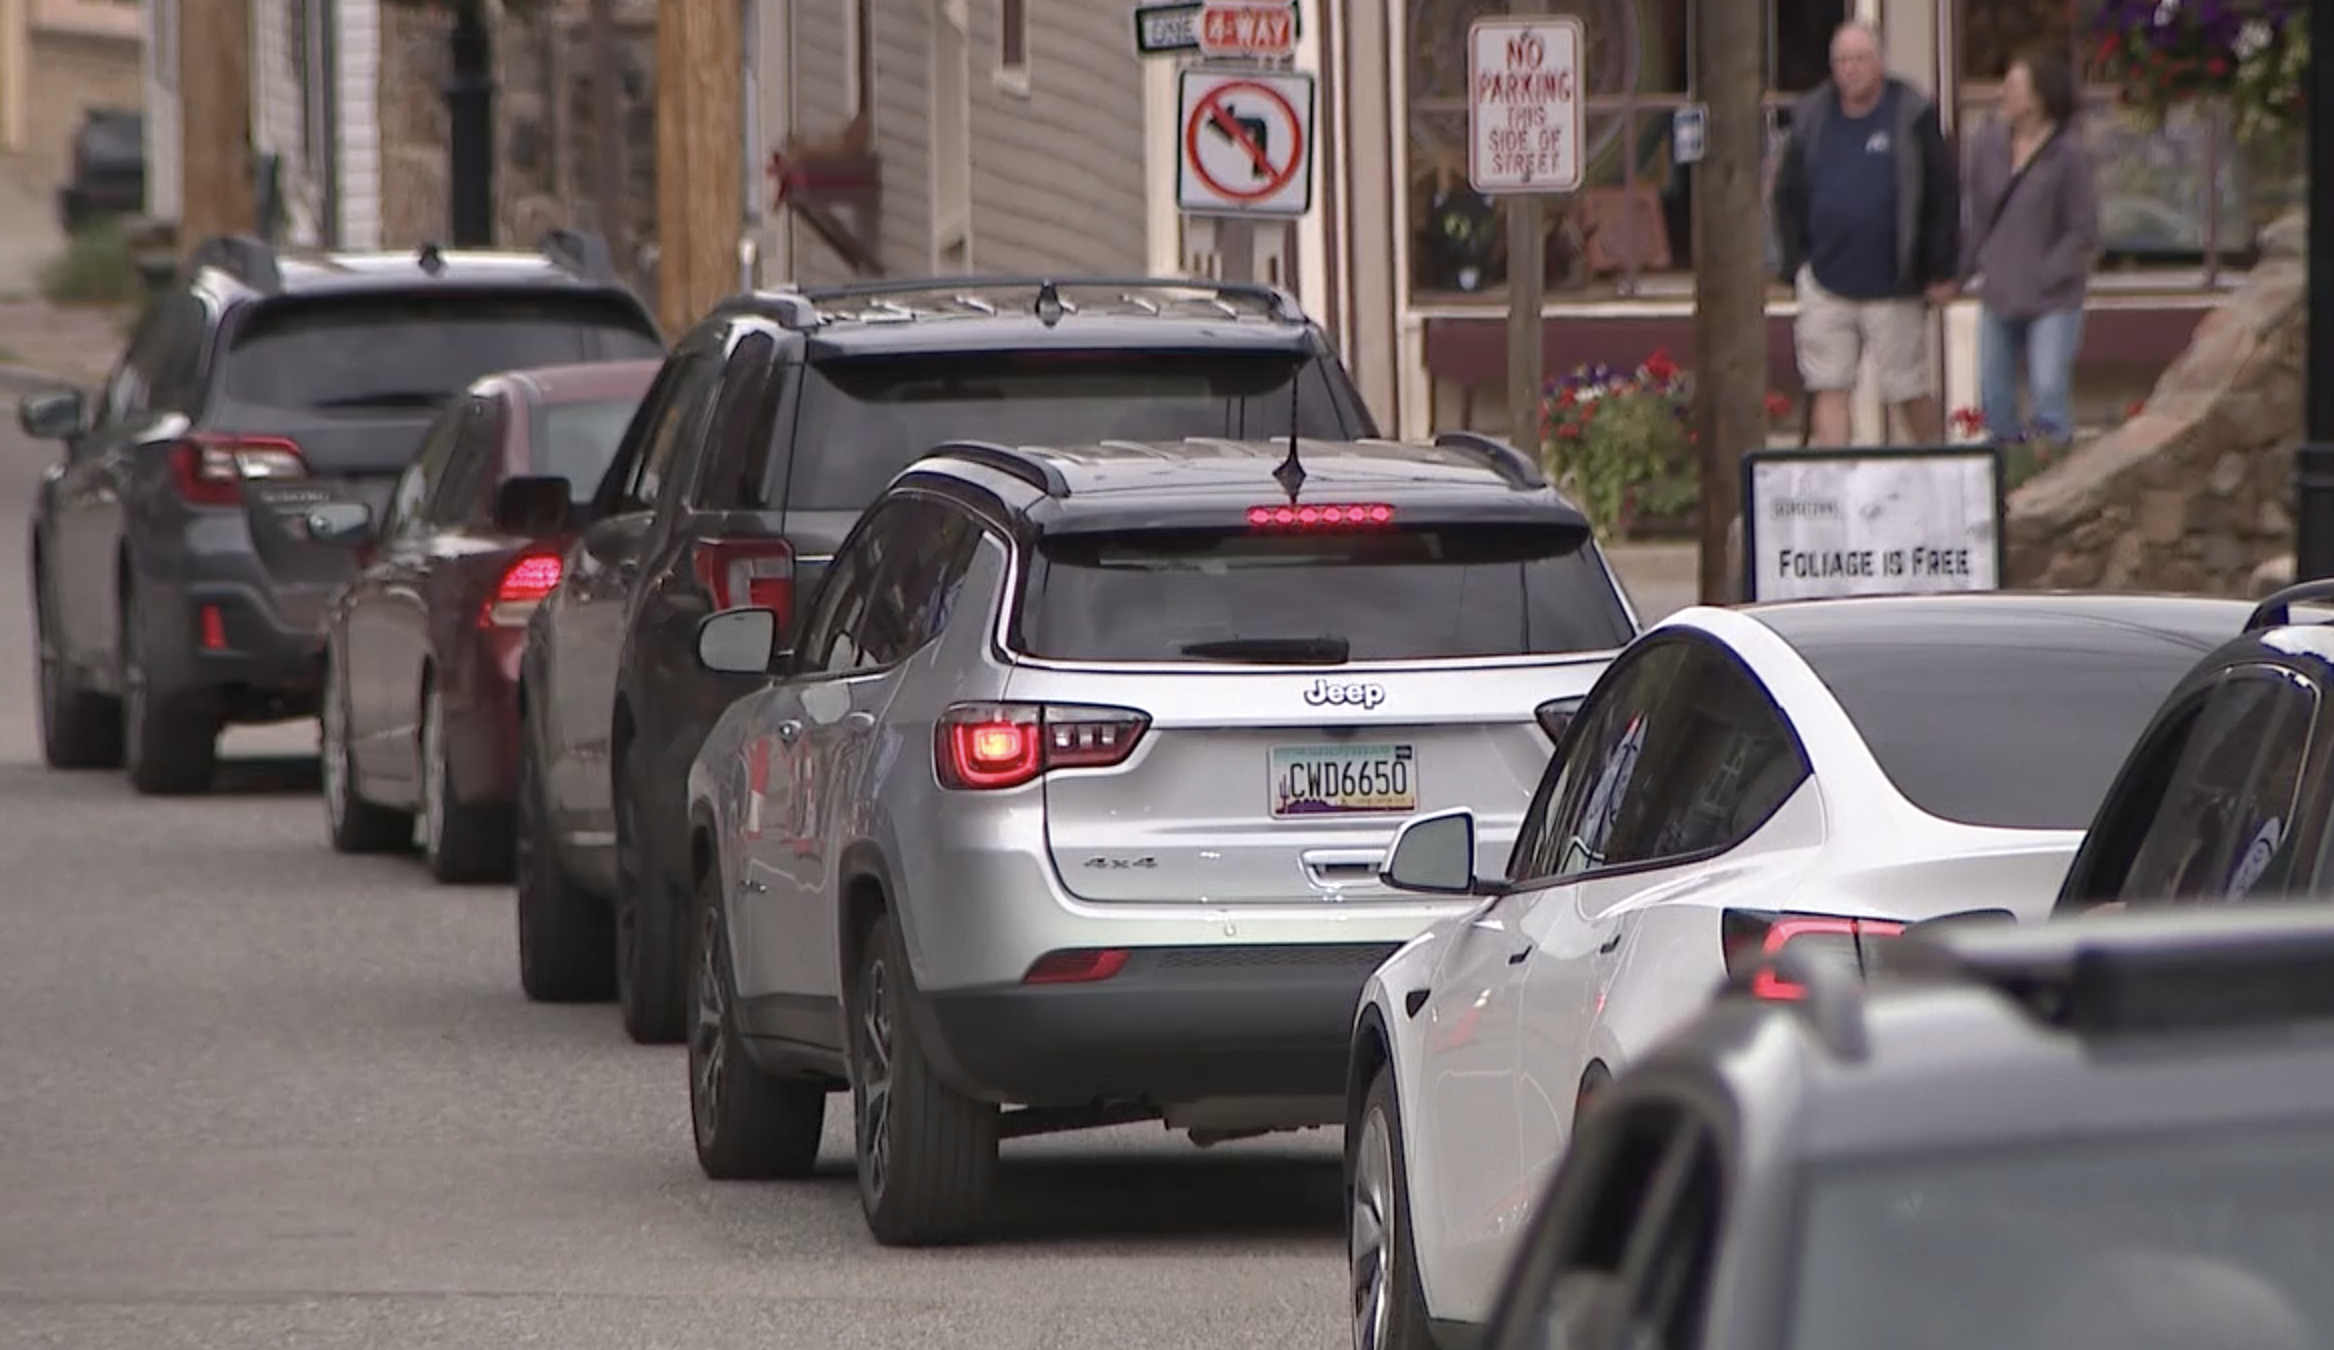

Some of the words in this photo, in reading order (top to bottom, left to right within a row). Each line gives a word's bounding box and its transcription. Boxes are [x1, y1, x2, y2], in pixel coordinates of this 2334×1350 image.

[1151, 17, 1194, 45] ONE
[1208, 11, 1289, 46] 4-WAY
[1507, 36, 1544, 70] NO
[1479, 72, 1571, 103] PARKING
[1506, 106, 1546, 129] THIS
[1489, 130, 1528, 152] SIDE
[1538, 130, 1561, 152] OF
[1492, 153, 1561, 174] STREET
[1778, 549, 1874, 578] FOLIAGE
[1883, 551, 1903, 575] IS
[1912, 547, 1969, 576] FREE
[1304, 679, 1386, 711] Jeep
[1290, 760, 1407, 798] CWD6650
[1083, 856, 1158, 868] 4x4
